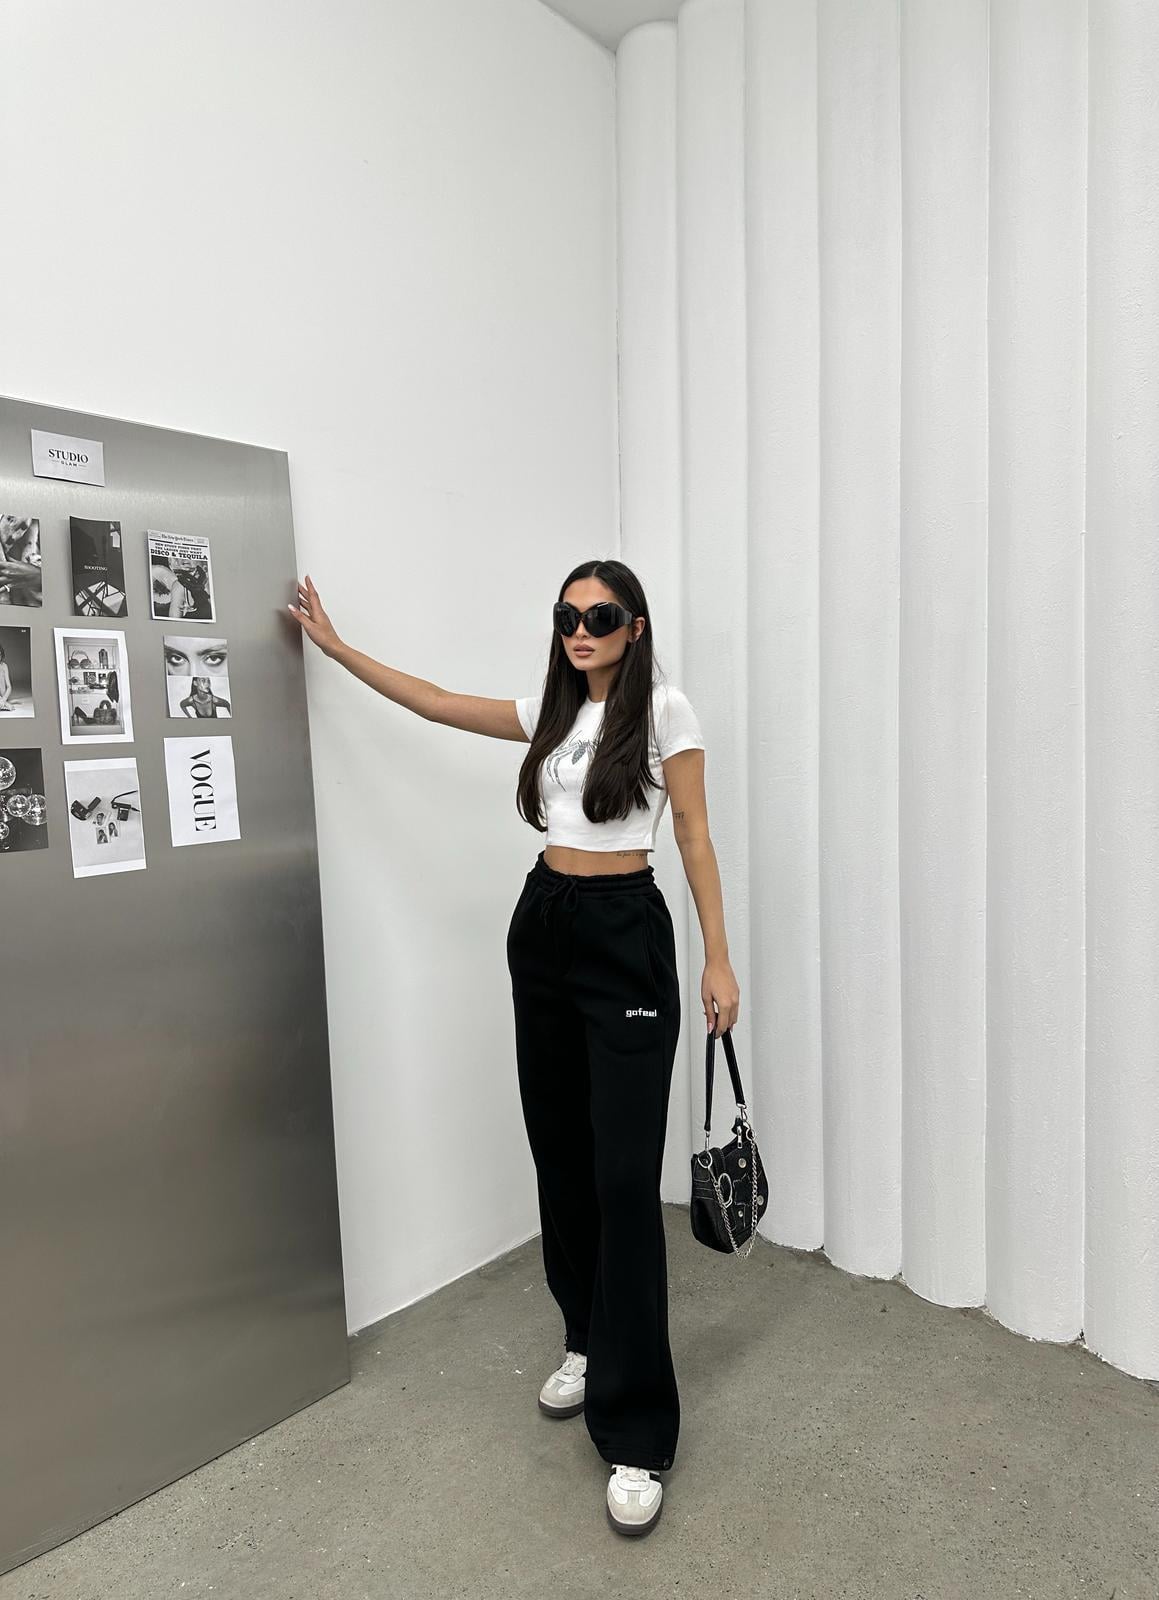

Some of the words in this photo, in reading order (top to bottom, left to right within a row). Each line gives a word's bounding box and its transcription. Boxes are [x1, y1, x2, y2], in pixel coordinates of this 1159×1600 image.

[49, 449, 88, 463] STUDIO
[178, 552, 208, 560] TEQUILA
[190, 749, 217, 831] VOGUE
[625, 1007, 657, 1017] gofeel
